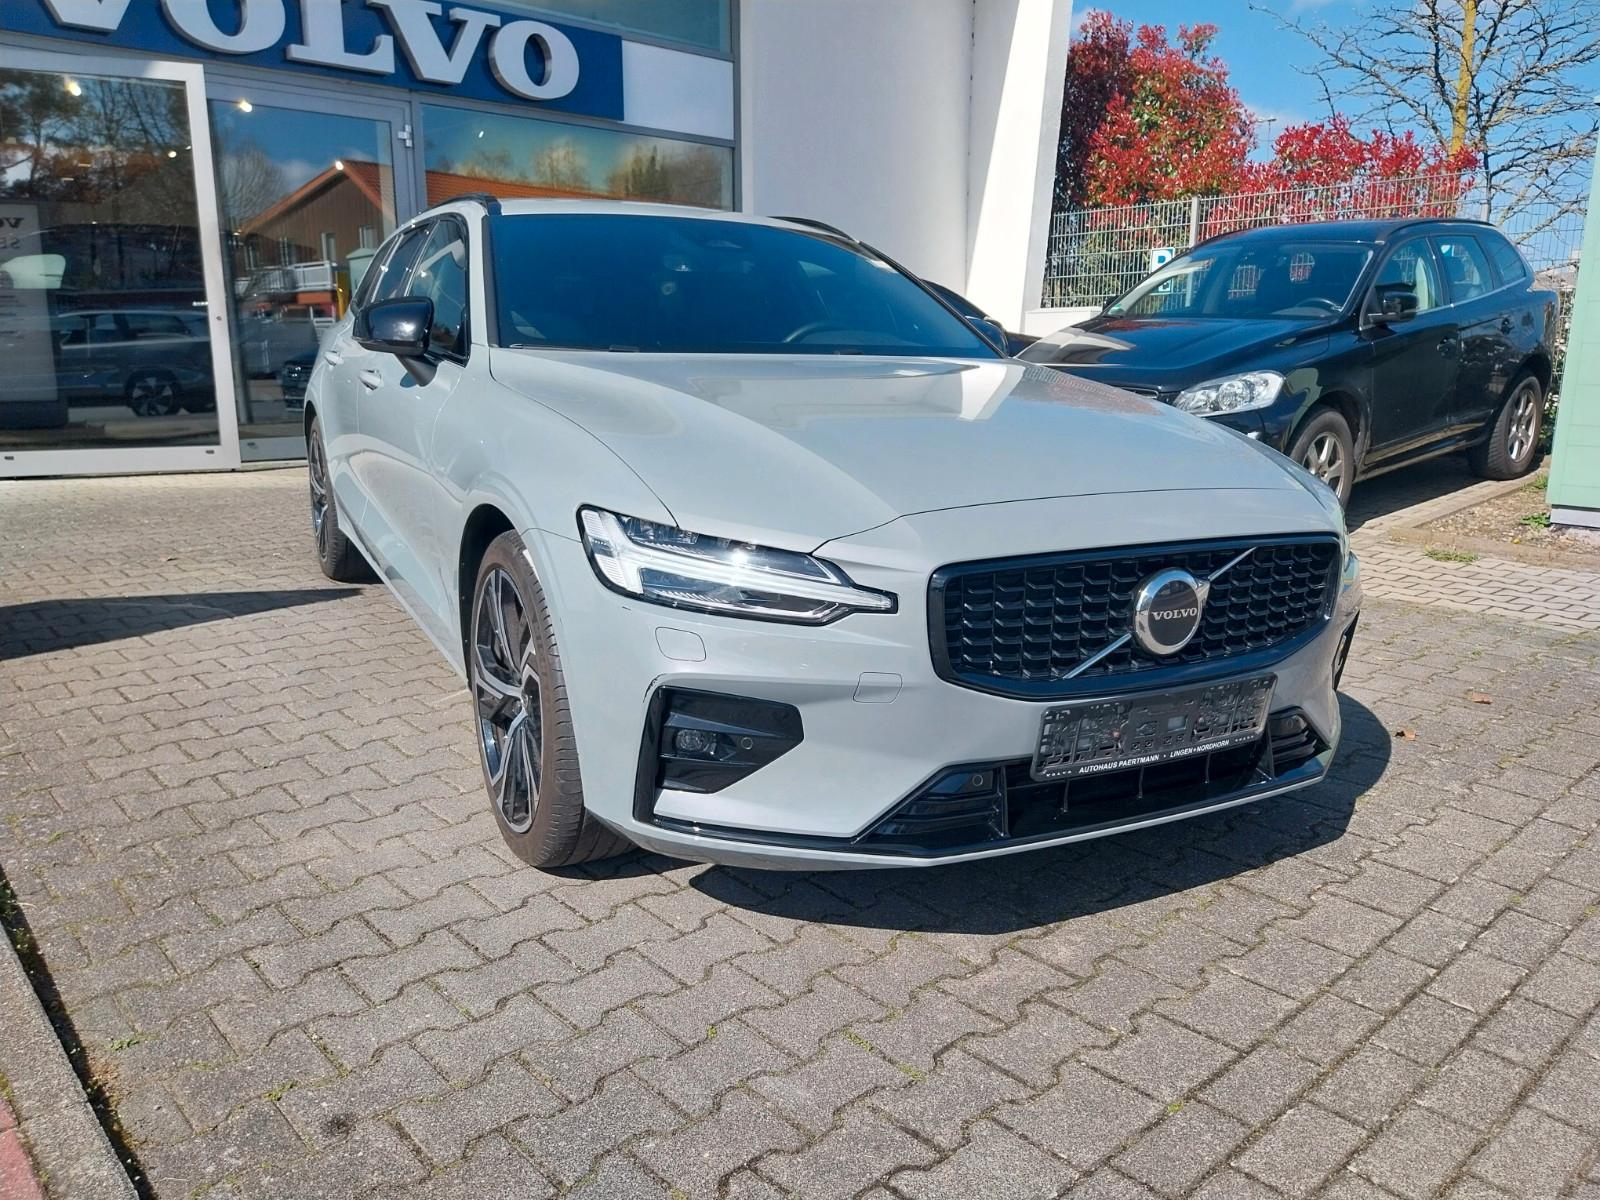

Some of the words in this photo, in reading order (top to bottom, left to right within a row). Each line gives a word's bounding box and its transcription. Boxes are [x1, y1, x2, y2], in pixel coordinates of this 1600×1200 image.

[1152, 607, 1198, 621] VOLVO
[1078, 761, 1118, 774] AUTOHAUS
[1118, 754, 1160, 768] PAERTMANN
[1169, 747, 1194, 758] LINGEN
[1196, 739, 1230, 752] NORDHORN
